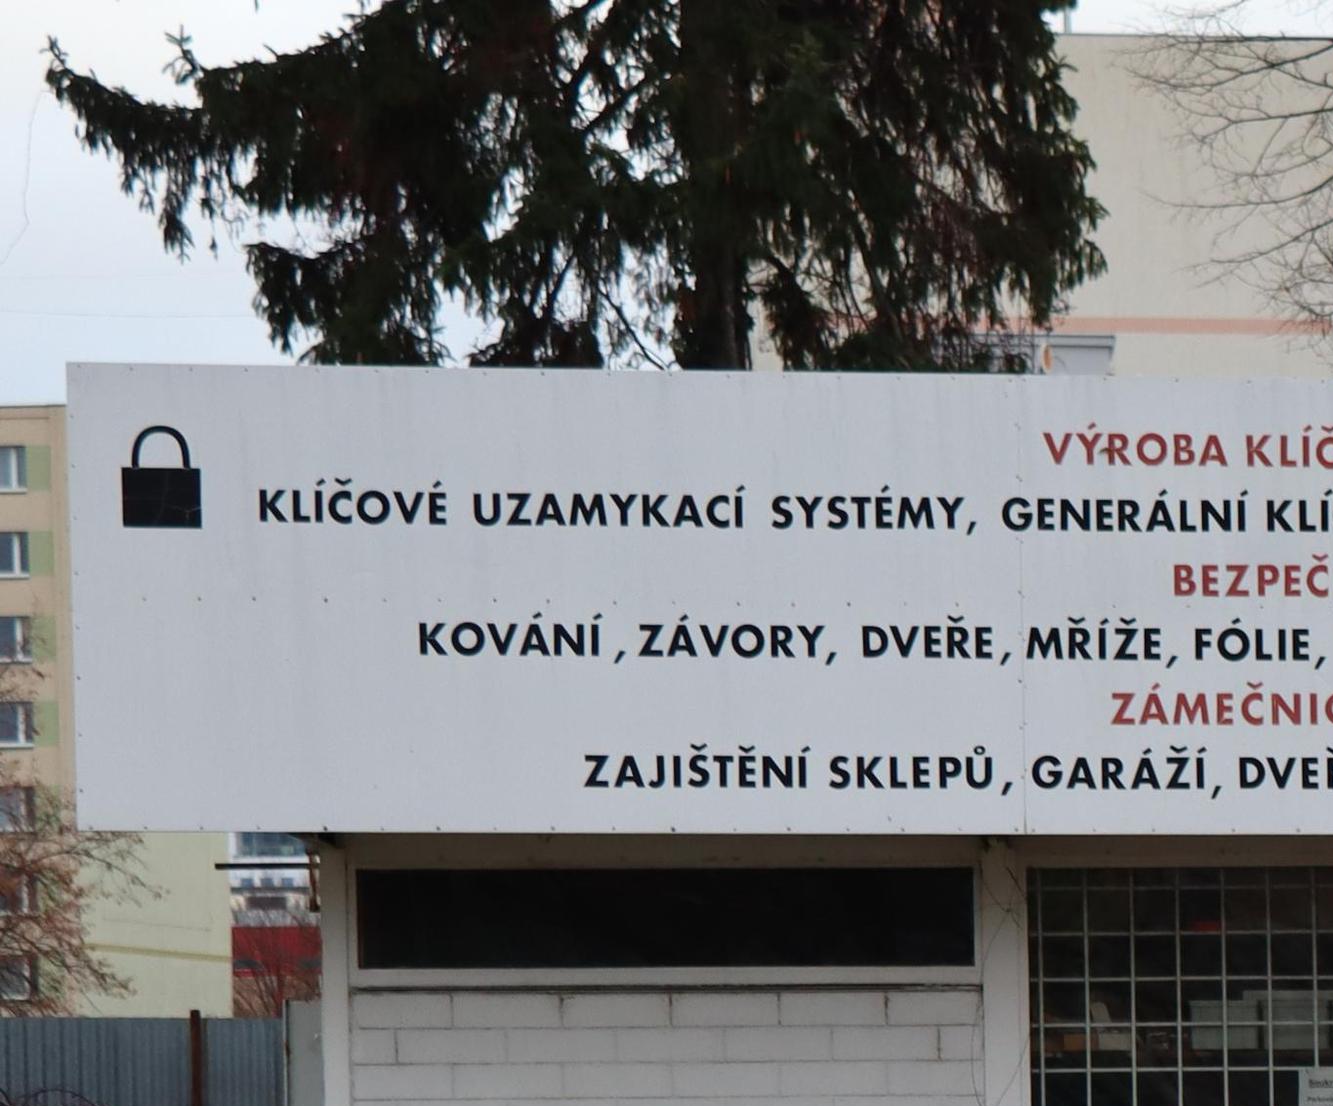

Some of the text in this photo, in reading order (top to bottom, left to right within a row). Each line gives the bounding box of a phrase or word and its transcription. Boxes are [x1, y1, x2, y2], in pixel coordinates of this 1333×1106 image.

[1045, 424, 1226, 467] VÝROBA
[259, 478, 446, 525] KLÍČOVÉ
[473, 485, 744, 528] UZAMYKACÍ
[772, 485, 976, 535] SYSTÉMY,
[1002, 489, 1248, 532] GENERÁLNÍ
[639, 614, 837, 665] ZÁVORY,
[862, 615, 1011, 665] DVEŘE,
[1026, 617, 1178, 668] MŘÍŽE,
[1195, 618, 1326, 669] FÓLIE,
[584, 743, 810, 788] ZAJIŠTĚNÍ
[829, 746, 1013, 796] SKLEPŮ,
[1032, 745, 1222, 799] GARÁŽÍ,
